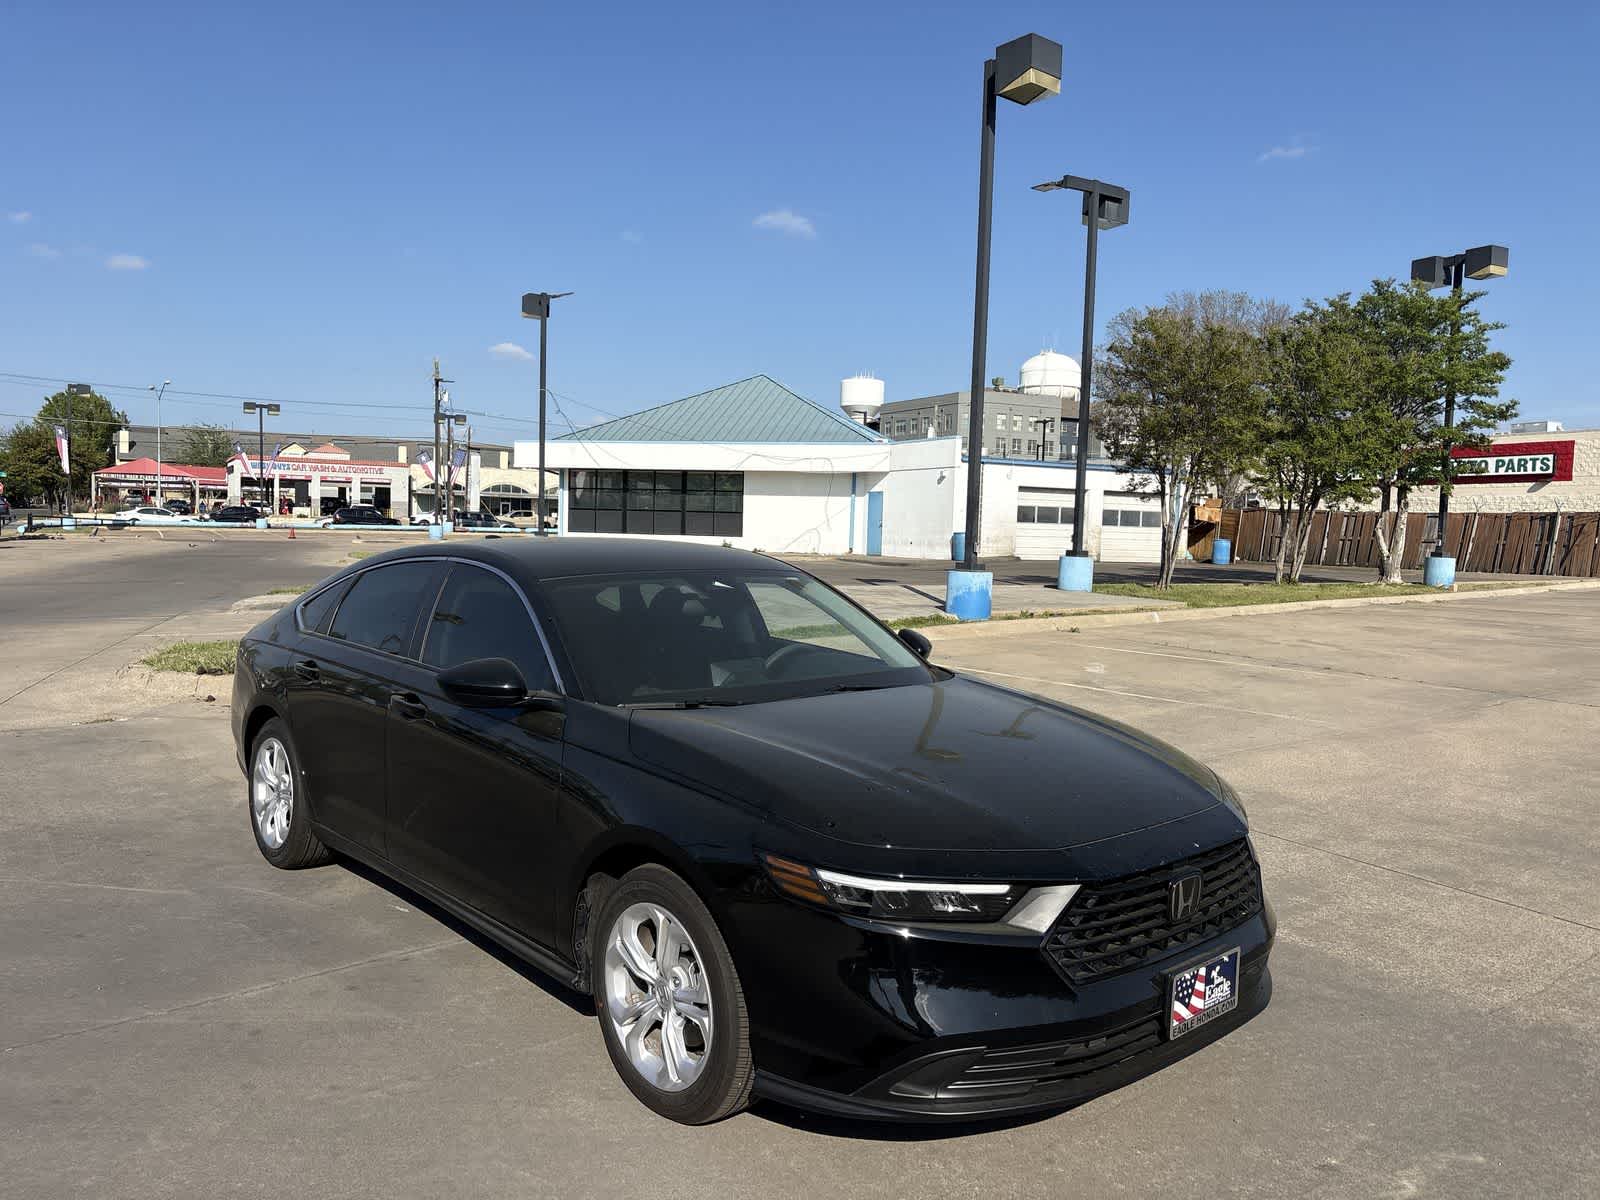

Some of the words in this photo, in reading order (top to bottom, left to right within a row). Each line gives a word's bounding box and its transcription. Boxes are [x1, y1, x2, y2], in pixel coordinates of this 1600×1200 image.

[291, 464, 307, 472] CAR
[308, 465, 330, 473] WASH
[338, 466, 384, 475] AUTOMOTIVE
[1495, 457, 1550, 473] PARTS
[1172, 1018, 1195, 1037] EAGLE
